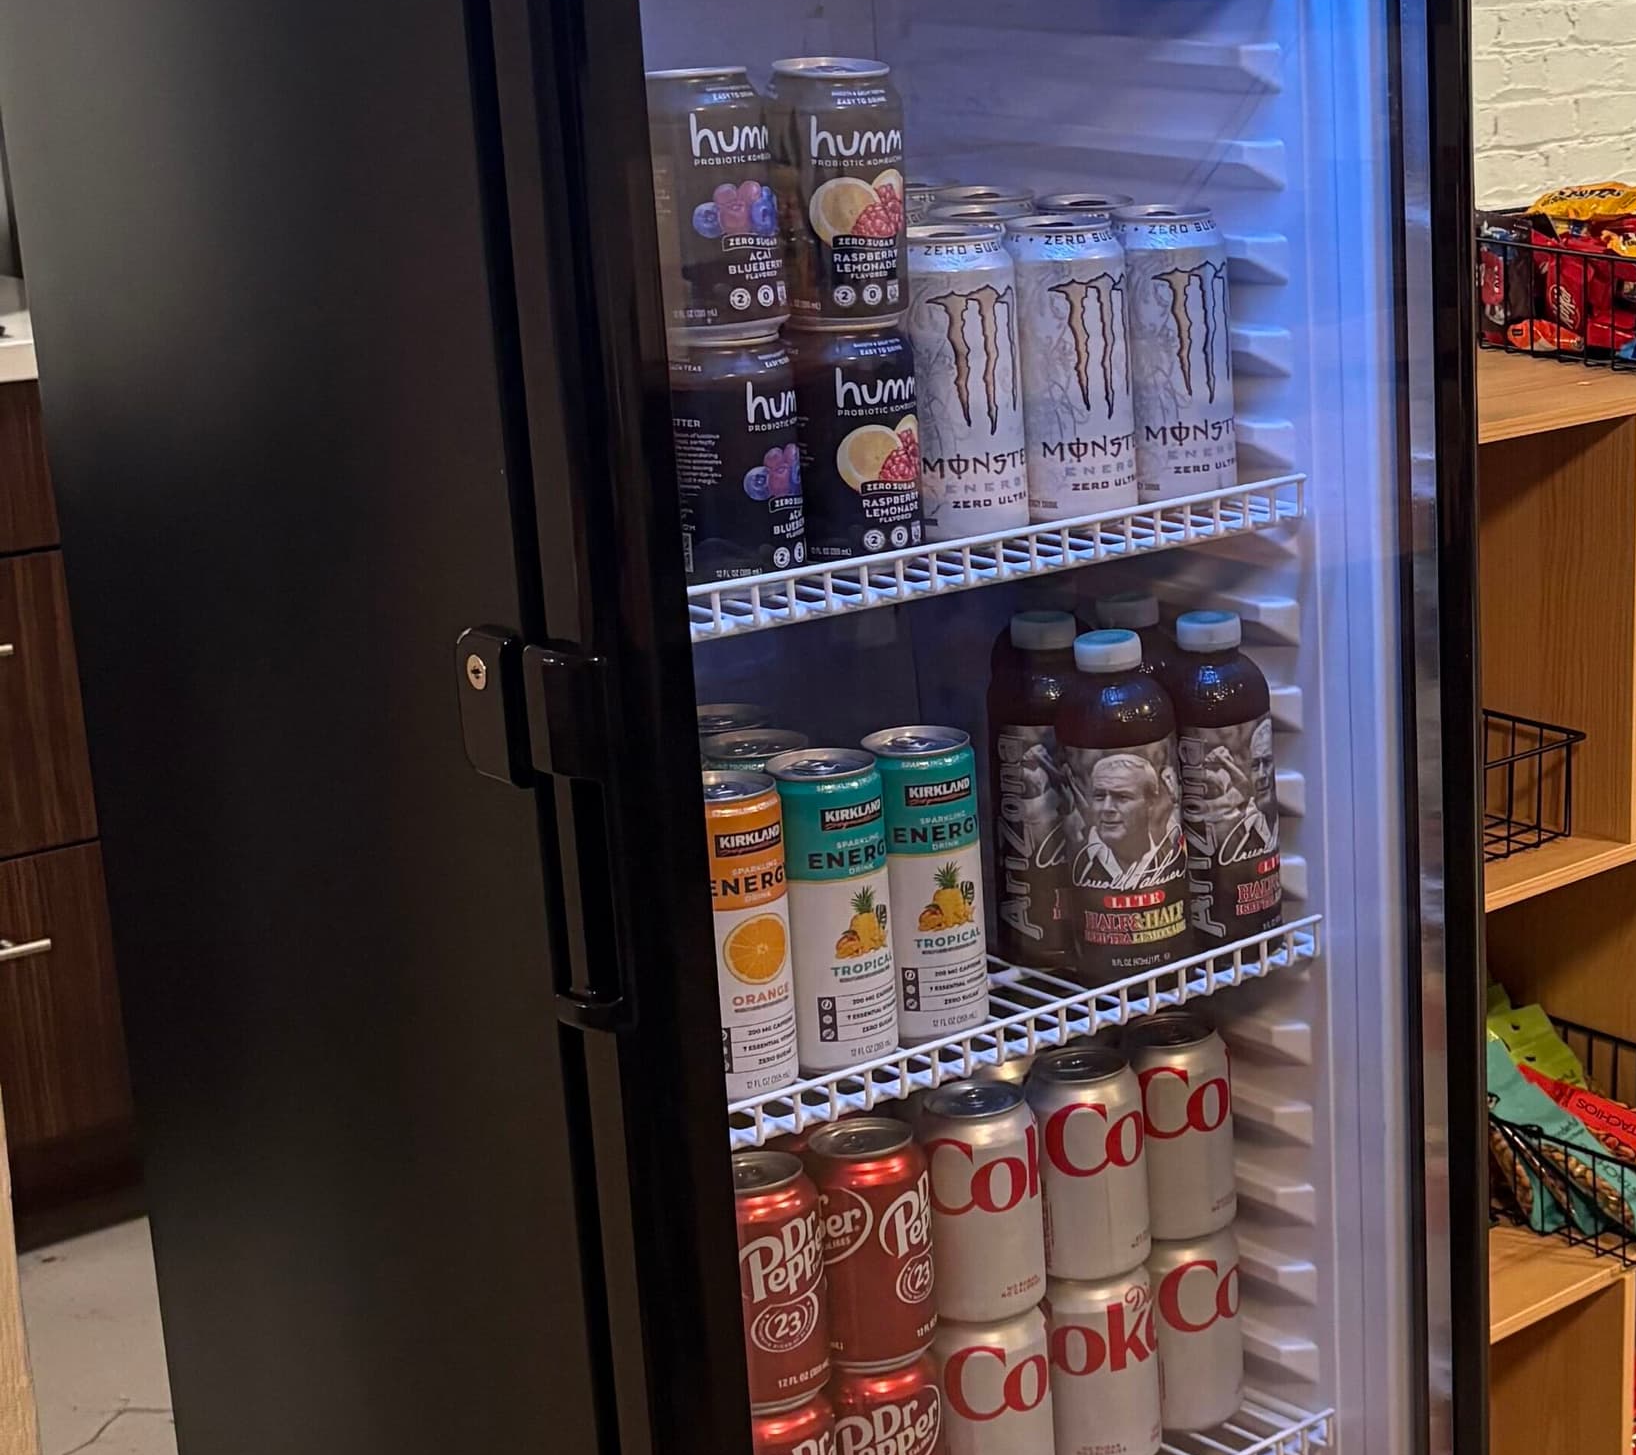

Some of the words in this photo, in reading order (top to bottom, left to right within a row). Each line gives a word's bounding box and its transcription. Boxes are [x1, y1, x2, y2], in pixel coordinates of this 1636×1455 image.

[810, 115, 902, 158] humm
[694, 154, 746, 166] PROBIOTIC
[811, 158, 865, 167] PROBIOTIC
[1148, 223, 1189, 235] ZERO
[729, 238, 754, 247] ZERO
[838, 237, 865, 246] ZERO
[866, 237, 894, 246] SUGAR
[1044, 235, 1086, 245] ZERO
[1093, 232, 1112, 242] SUG
[833, 248, 898, 263] RASPBERRY
[924, 246, 967, 256] ZERO
[975, 242, 1001, 254] SUG
[728, 259, 783, 275] BLUEBERRY
[836, 259, 897, 274] LEMONADE
[838, 406, 888, 417] PROBIOTIC
[748, 419, 790, 432] PROBIOTIC
[1145, 417, 1236, 446] MONST
[1042, 433, 1136, 463] MONST
[922, 447, 1027, 480] MONSTE
[1173, 465, 1210, 475] ZERO
[866, 482, 892, 491] ZERO
[893, 481, 915, 491] SUGAR
[1072, 481, 1109, 491] ZERO
[862, 491, 919, 508] RASPBERRY
[952, 497, 992, 509] ZERO
[866, 502, 919, 518] LEMONADE
[908, 776, 970, 799] KIRKLAND
[824, 797, 881, 823] KIRKLAND
[920, 809, 966, 825] SPARKLING
[719, 824, 781, 849] KIRKLAND
[836, 833, 879, 849] SPARKLING
[932, 839, 959, 851] DRINK
[808, 839, 886, 870] ENERG
[732, 859, 777, 877] SPARKLING
[710, 862, 786, 897] ENERG
[1111, 891, 1162, 909] LITE
[914, 927, 981, 949] TROPICAL
[934, 981, 965, 992] ESSENTIAL
[732, 982, 790, 1008] ORANGE
[944, 997, 961, 1006] ZERO
[862, 1024, 878, 1034] ZERO
[748, 1038, 779, 1052] ESSENTIAL
[758, 1055, 775, 1065] ZERO
[1139, 1066, 1231, 1139] Co
[1045, 1102, 1144, 1178] Co
[781, 1210, 816, 1261] Dr
[914, 1260, 931, 1291] 23
[1158, 1259, 1240, 1333] Co
[774, 1311, 802, 1339] 23
[778, 1378, 788, 1389] 12
[788, 1375, 798, 1387] FL
[943, 1345, 1048, 1422] Co
[872, 1399, 918, 1443] Dr
